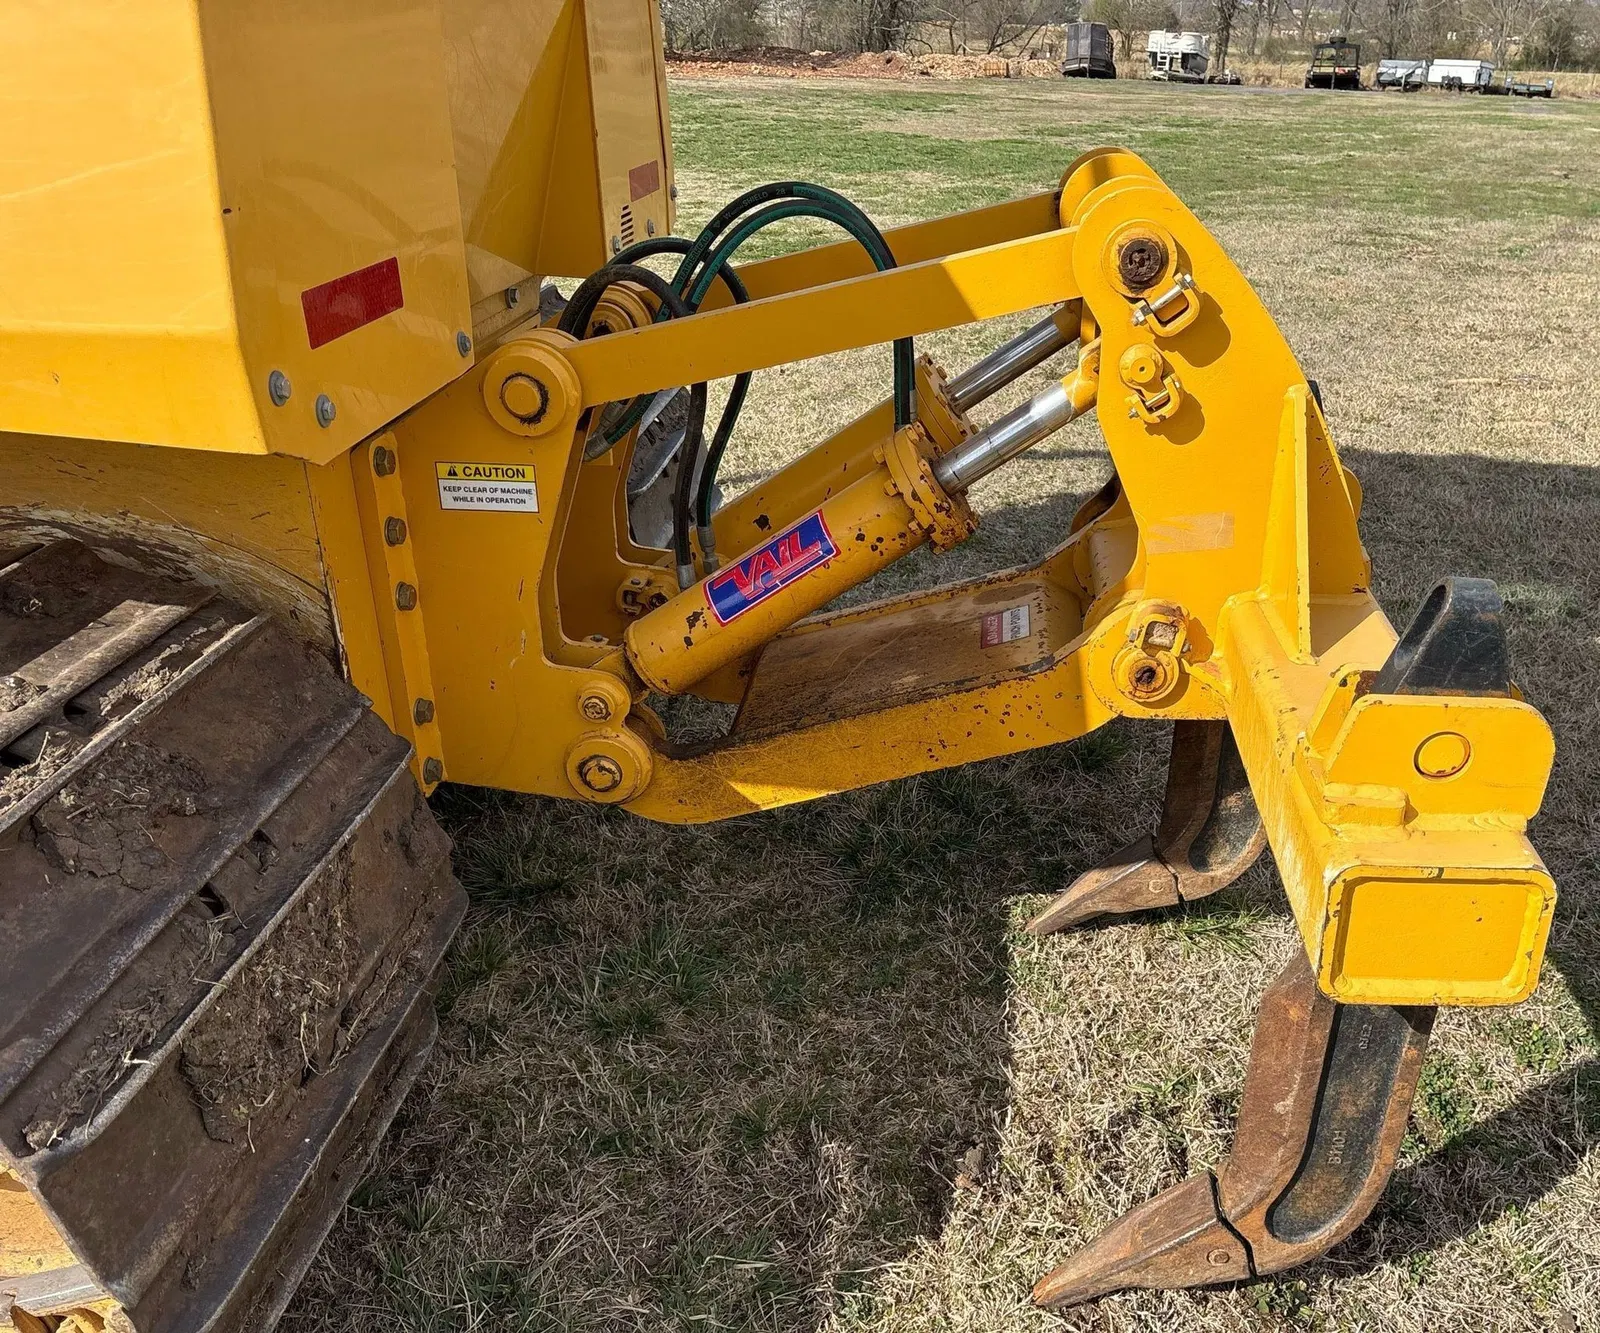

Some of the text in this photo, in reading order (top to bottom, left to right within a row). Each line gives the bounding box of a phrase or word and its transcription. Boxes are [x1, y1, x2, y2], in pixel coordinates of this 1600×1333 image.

[462, 466, 526, 479] CAUTION
[443, 485, 462, 493] KEEP
[463, 486, 488, 494] CLEAR
[500, 487, 533, 495] MACHINE
[485, 497, 526, 505] OPERATION
[712, 530, 823, 600] VAIL
